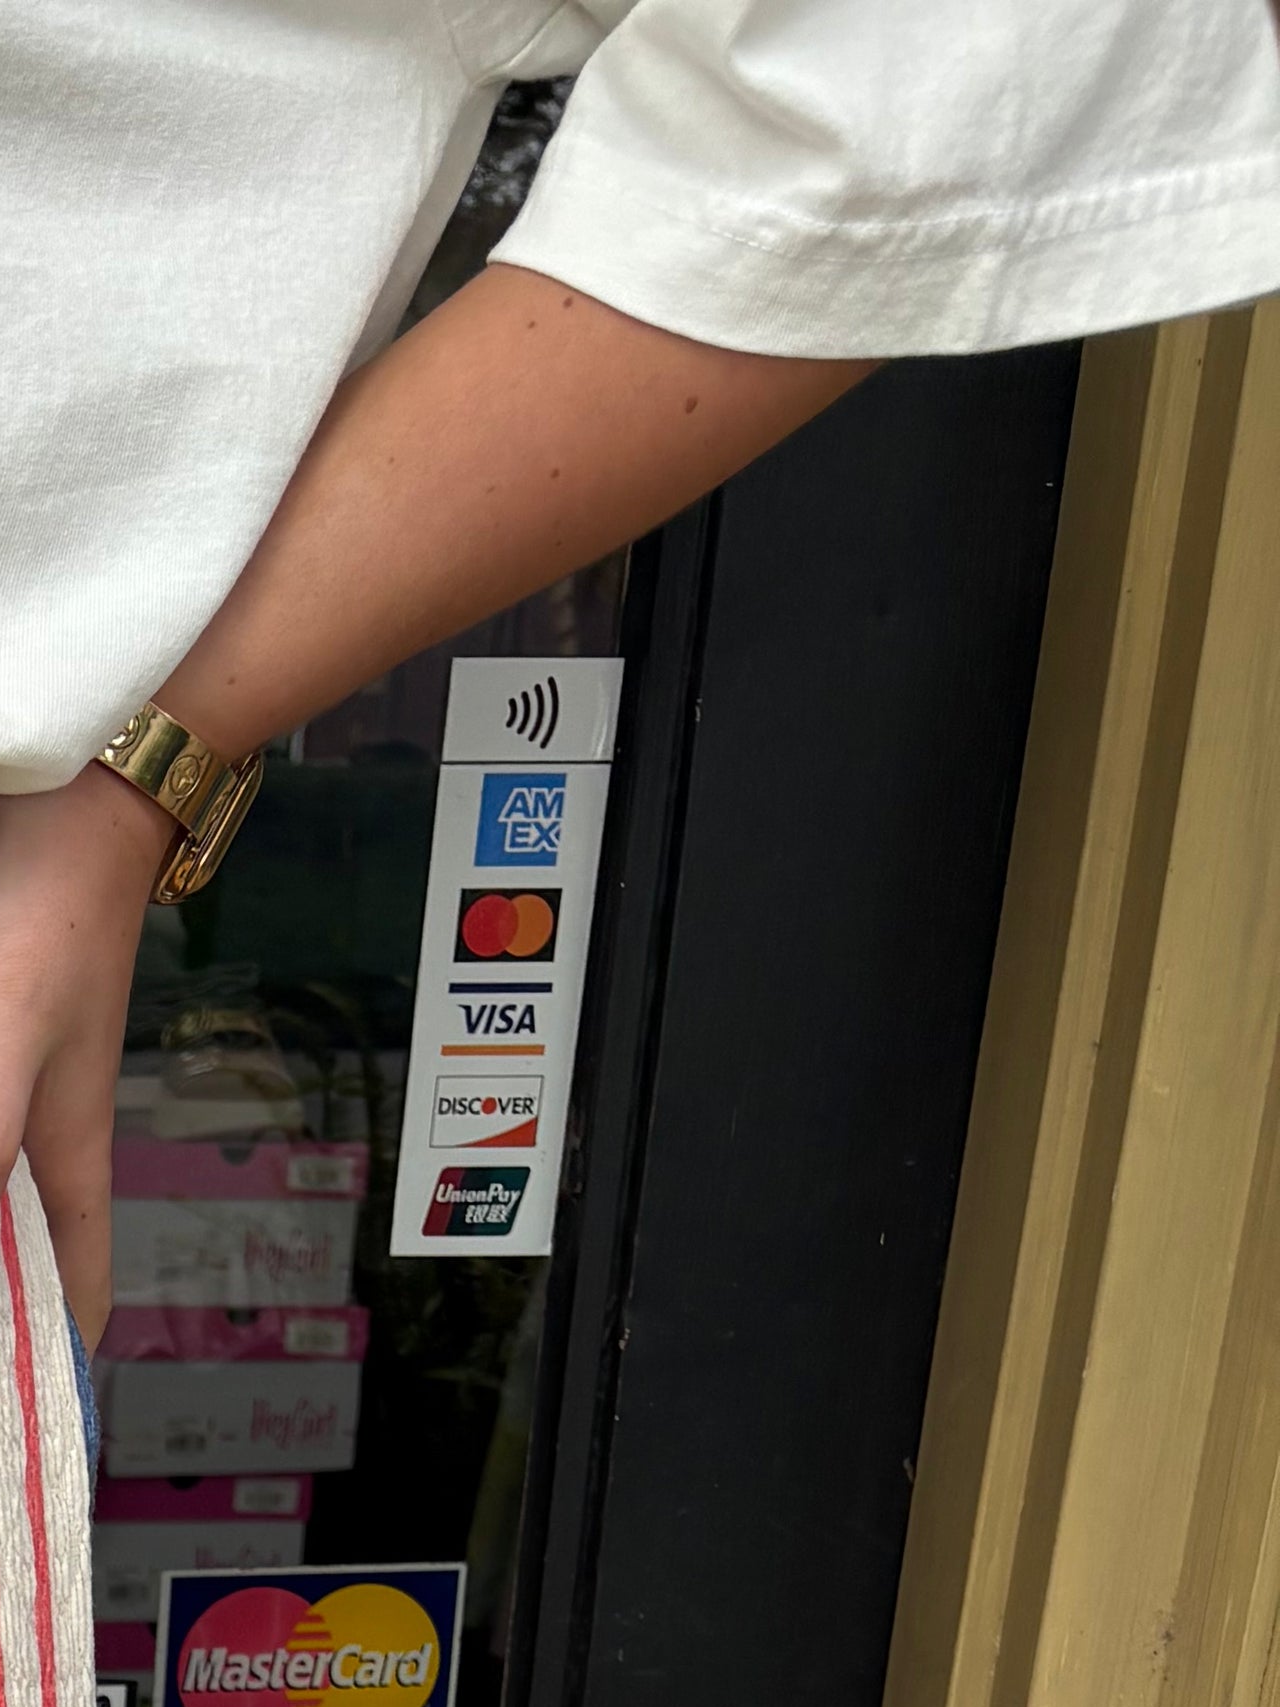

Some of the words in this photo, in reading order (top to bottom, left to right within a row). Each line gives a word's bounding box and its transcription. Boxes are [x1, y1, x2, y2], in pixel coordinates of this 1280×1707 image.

[498, 787, 565, 822] AM
[505, 821, 561, 852] EX
[458, 1004, 536, 1035] VISA
[438, 1095, 536, 1117] DISCOVER
[435, 1182, 521, 1212] UnionPay
[182, 1643, 432, 1693] MasterCard
